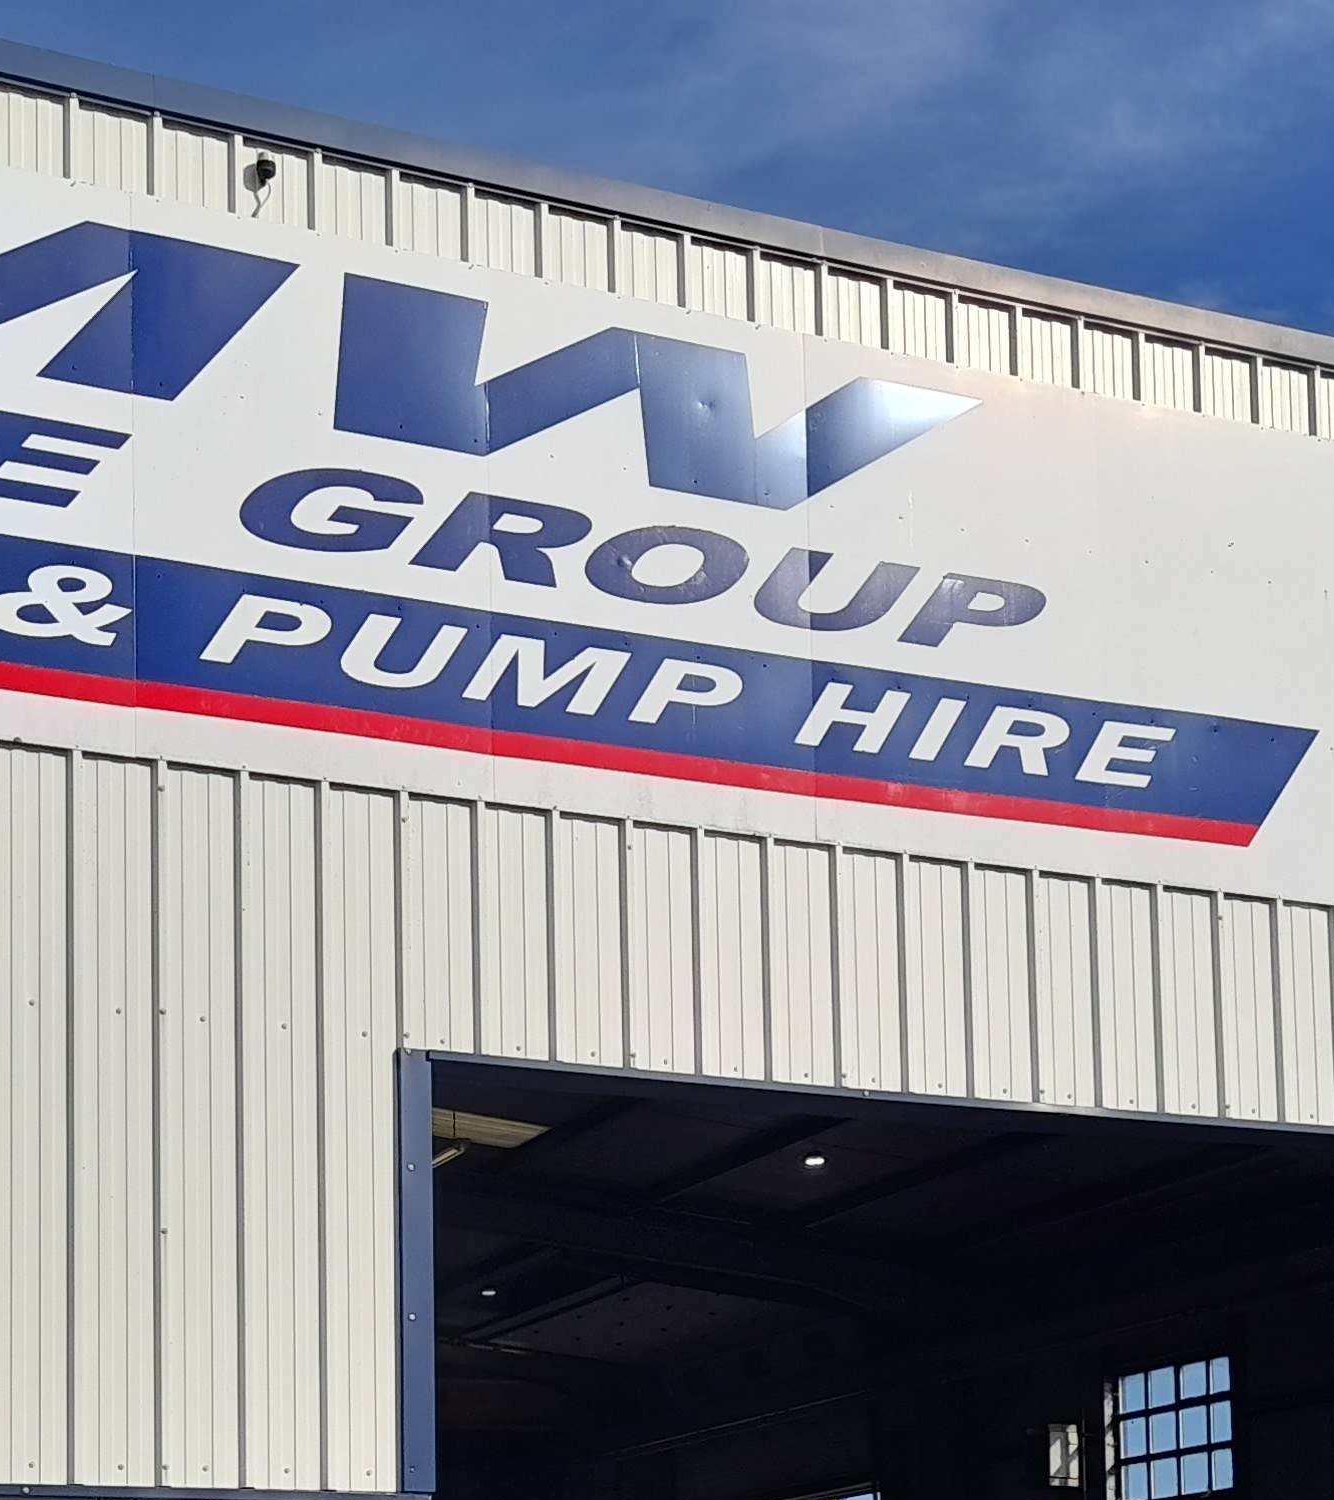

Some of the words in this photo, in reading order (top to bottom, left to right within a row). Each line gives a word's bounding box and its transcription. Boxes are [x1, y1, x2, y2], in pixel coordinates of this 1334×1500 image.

[239, 468, 1046, 647] GROUP
[199, 595, 744, 725] PUMP
[793, 682, 1175, 788] HIRE
